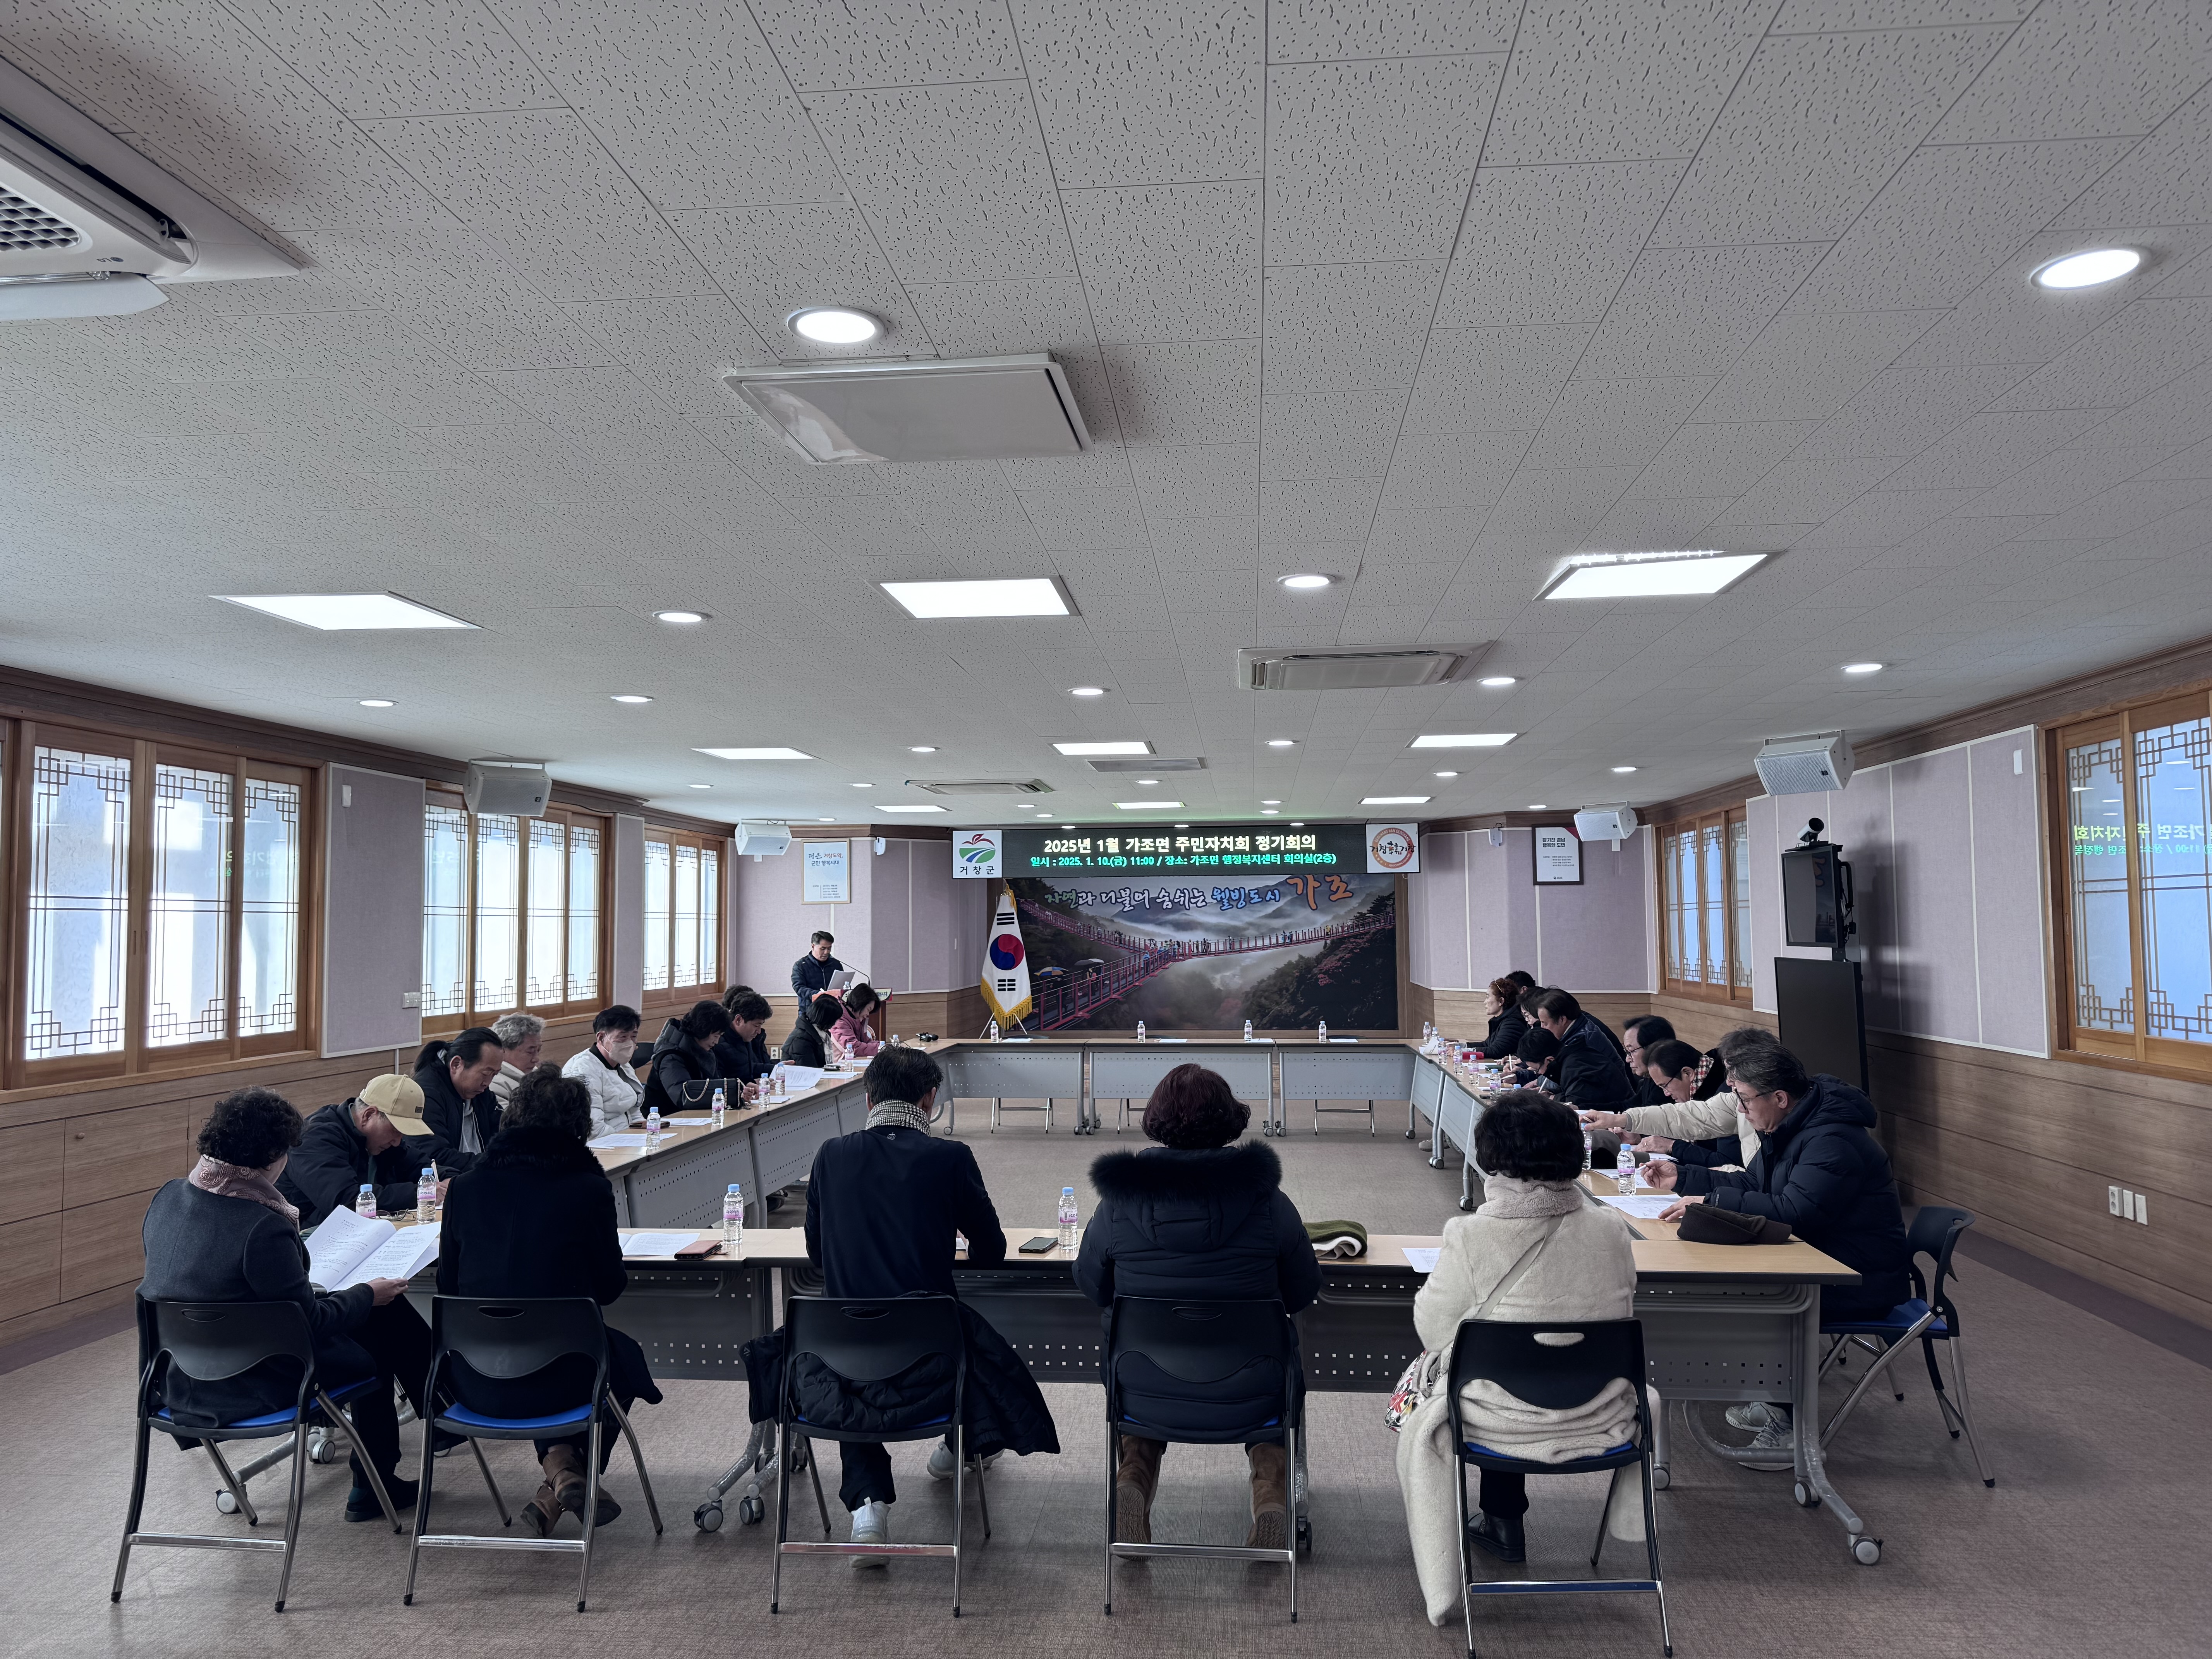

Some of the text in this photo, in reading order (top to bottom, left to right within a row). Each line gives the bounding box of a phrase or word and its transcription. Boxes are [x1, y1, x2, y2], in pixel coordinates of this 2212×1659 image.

[1044, 835, 1316, 854] 2025년 1월 가조면 주민자치회 정기회의
[1030, 857, 1049, 867] 일시
[1058, 857, 1083, 866] 2025.
[1086, 857, 1094, 866] 1.
[1097, 856, 1127, 867] 10.(금)
[1130, 856, 1154, 866] 11:00
[1156, 856, 1163, 866] /
[1164, 855, 1188, 866] 장소:
[1190, 855, 1219, 866] 가조면
[1222, 854, 1281, 865] 행정복지센터
[1284, 853, 1337, 865] 회의실(2층)
[960, 866, 994, 875] 거창군
[1045, 874, 1353, 912] 자연과 더불어 숨쉬는 웰빙도시 가조
